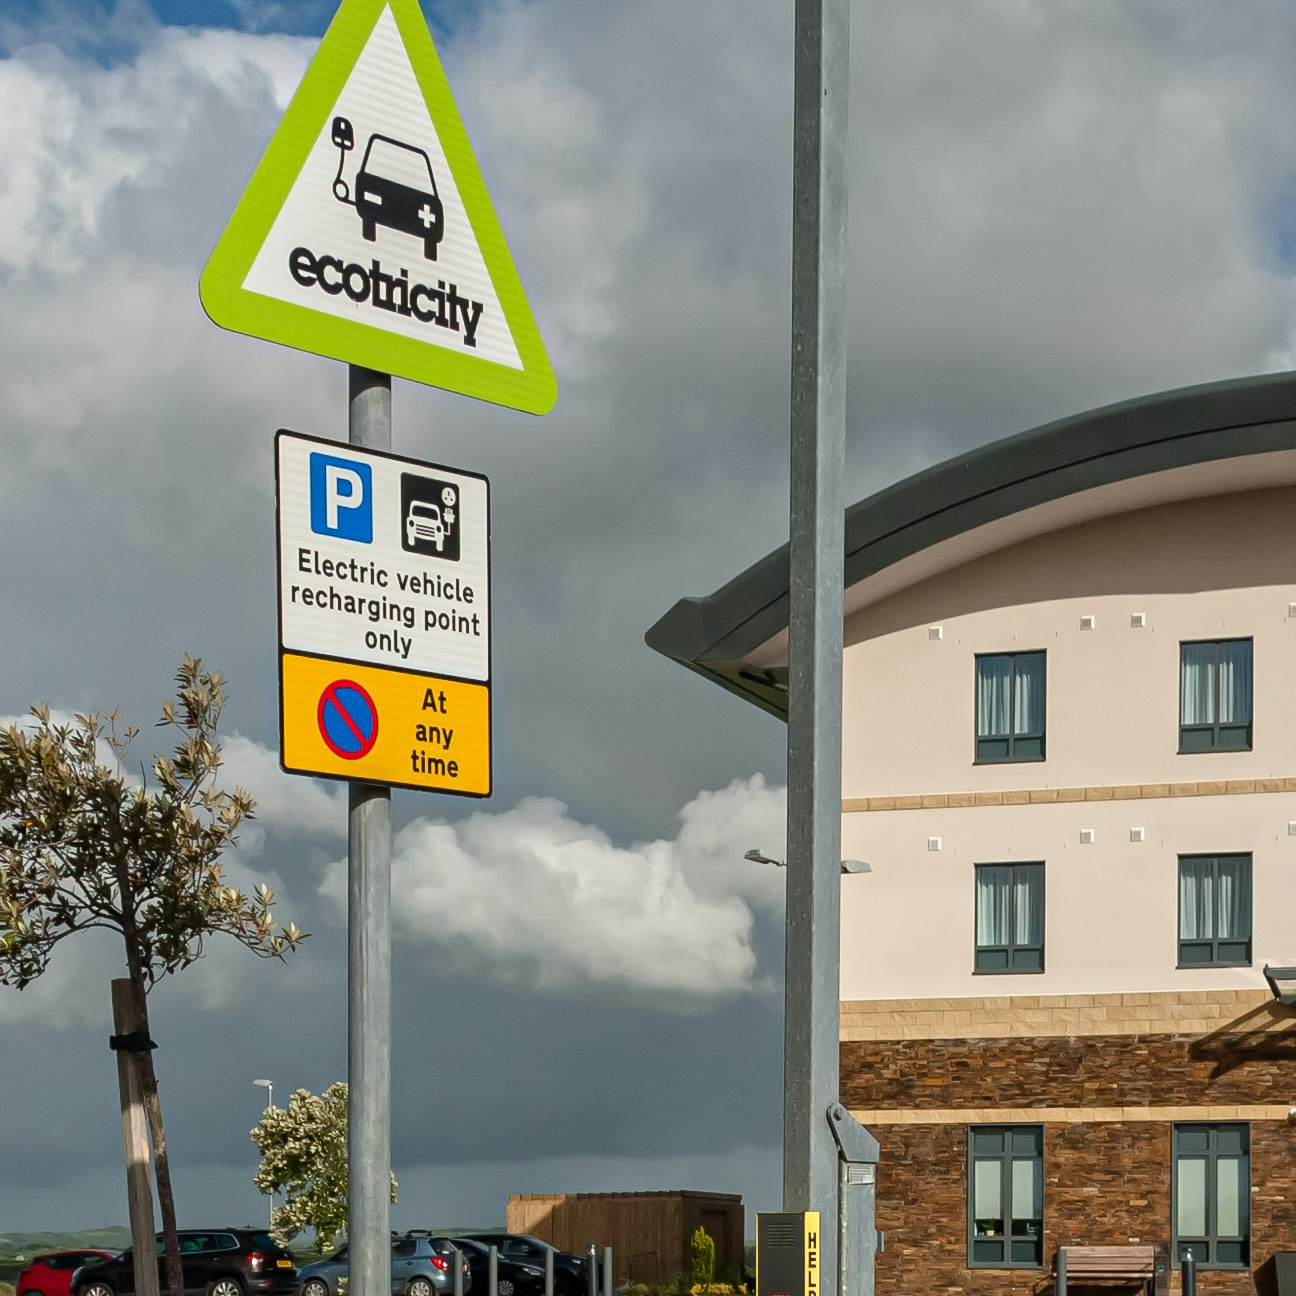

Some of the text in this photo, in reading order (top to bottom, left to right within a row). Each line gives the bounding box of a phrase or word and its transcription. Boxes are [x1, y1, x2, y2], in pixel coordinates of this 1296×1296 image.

[289, 246, 483, 347] ecotricity
[325, 464, 364, 529] P
[298, 548, 474, 604] Electric vehicle
[291, 584, 480, 636] recharging point
[365, 631, 412, 659] only
[422, 688, 447, 714] At
[415, 723, 453, 750] any
[411, 750, 459, 777] time
